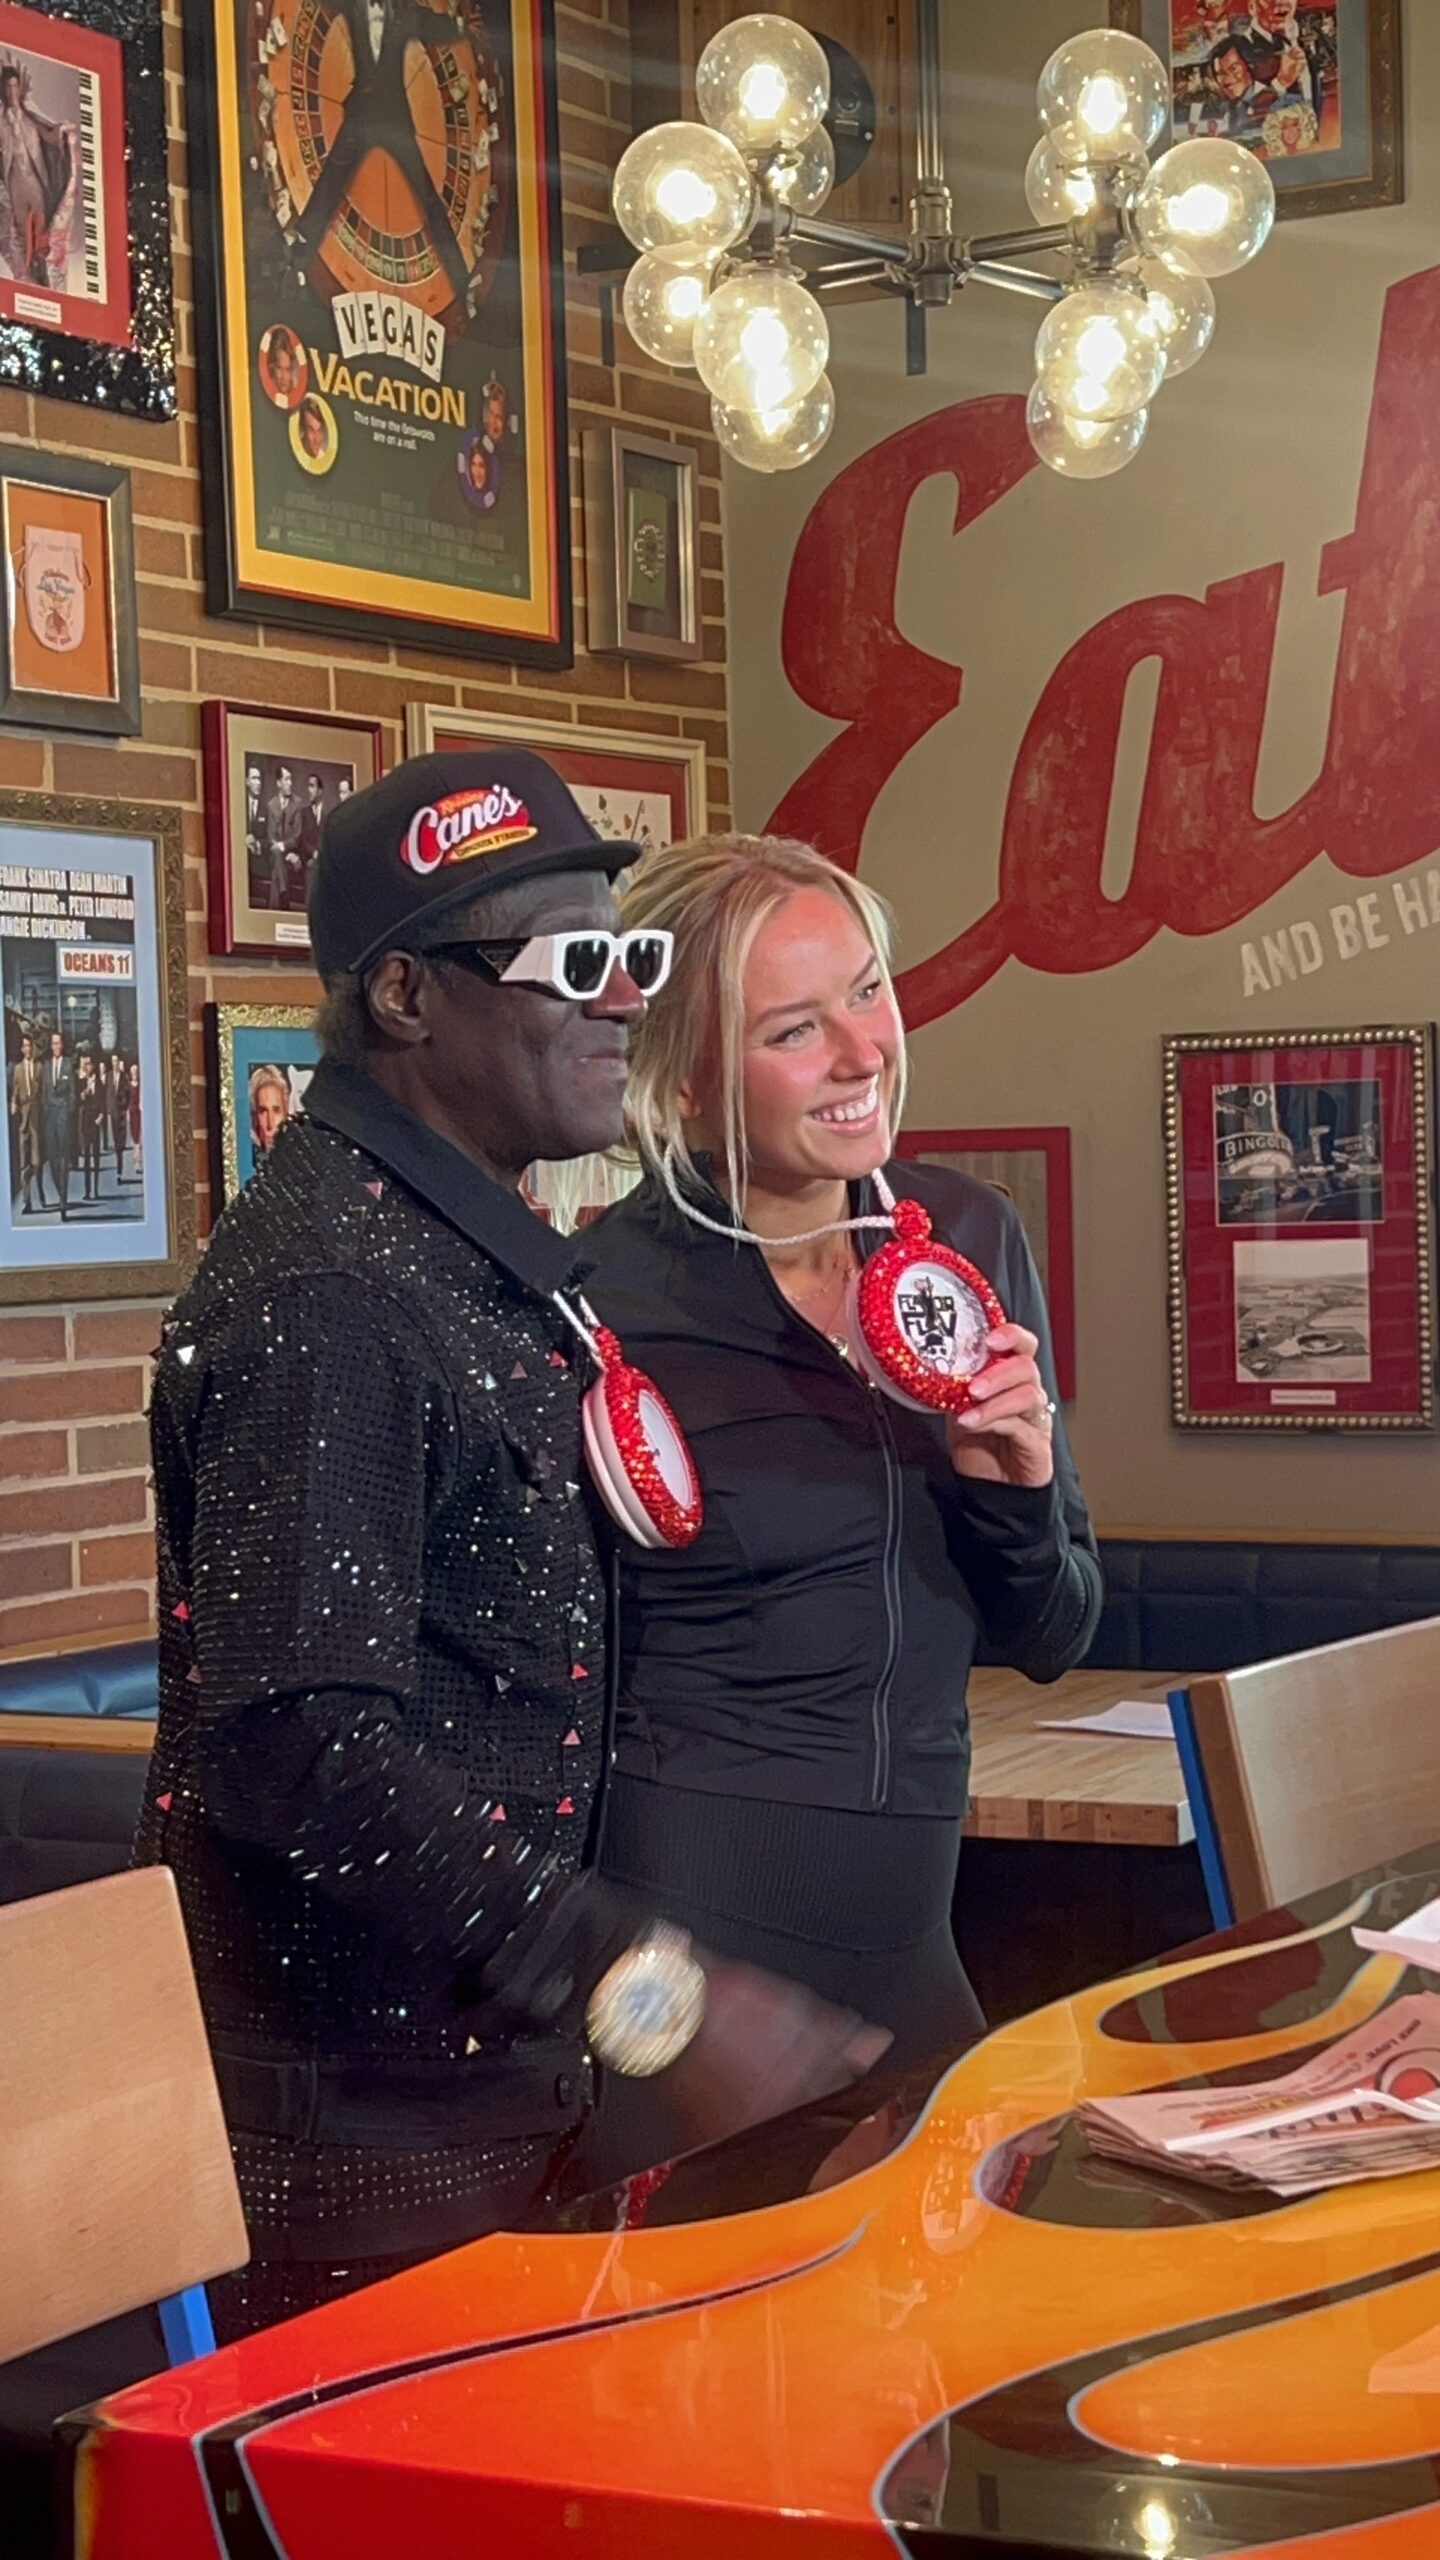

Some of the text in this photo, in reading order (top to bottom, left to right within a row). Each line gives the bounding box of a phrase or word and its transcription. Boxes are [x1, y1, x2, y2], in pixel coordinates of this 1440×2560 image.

[341, 303, 438, 366] VEGAS
[309, 347, 466, 428] VACATION
[408, 784, 523, 874] Cane's
[63, 952, 131, 974] OCEANS 11
[1240, 921, 1324, 998] AND
[1329, 892, 1390, 960] BE
